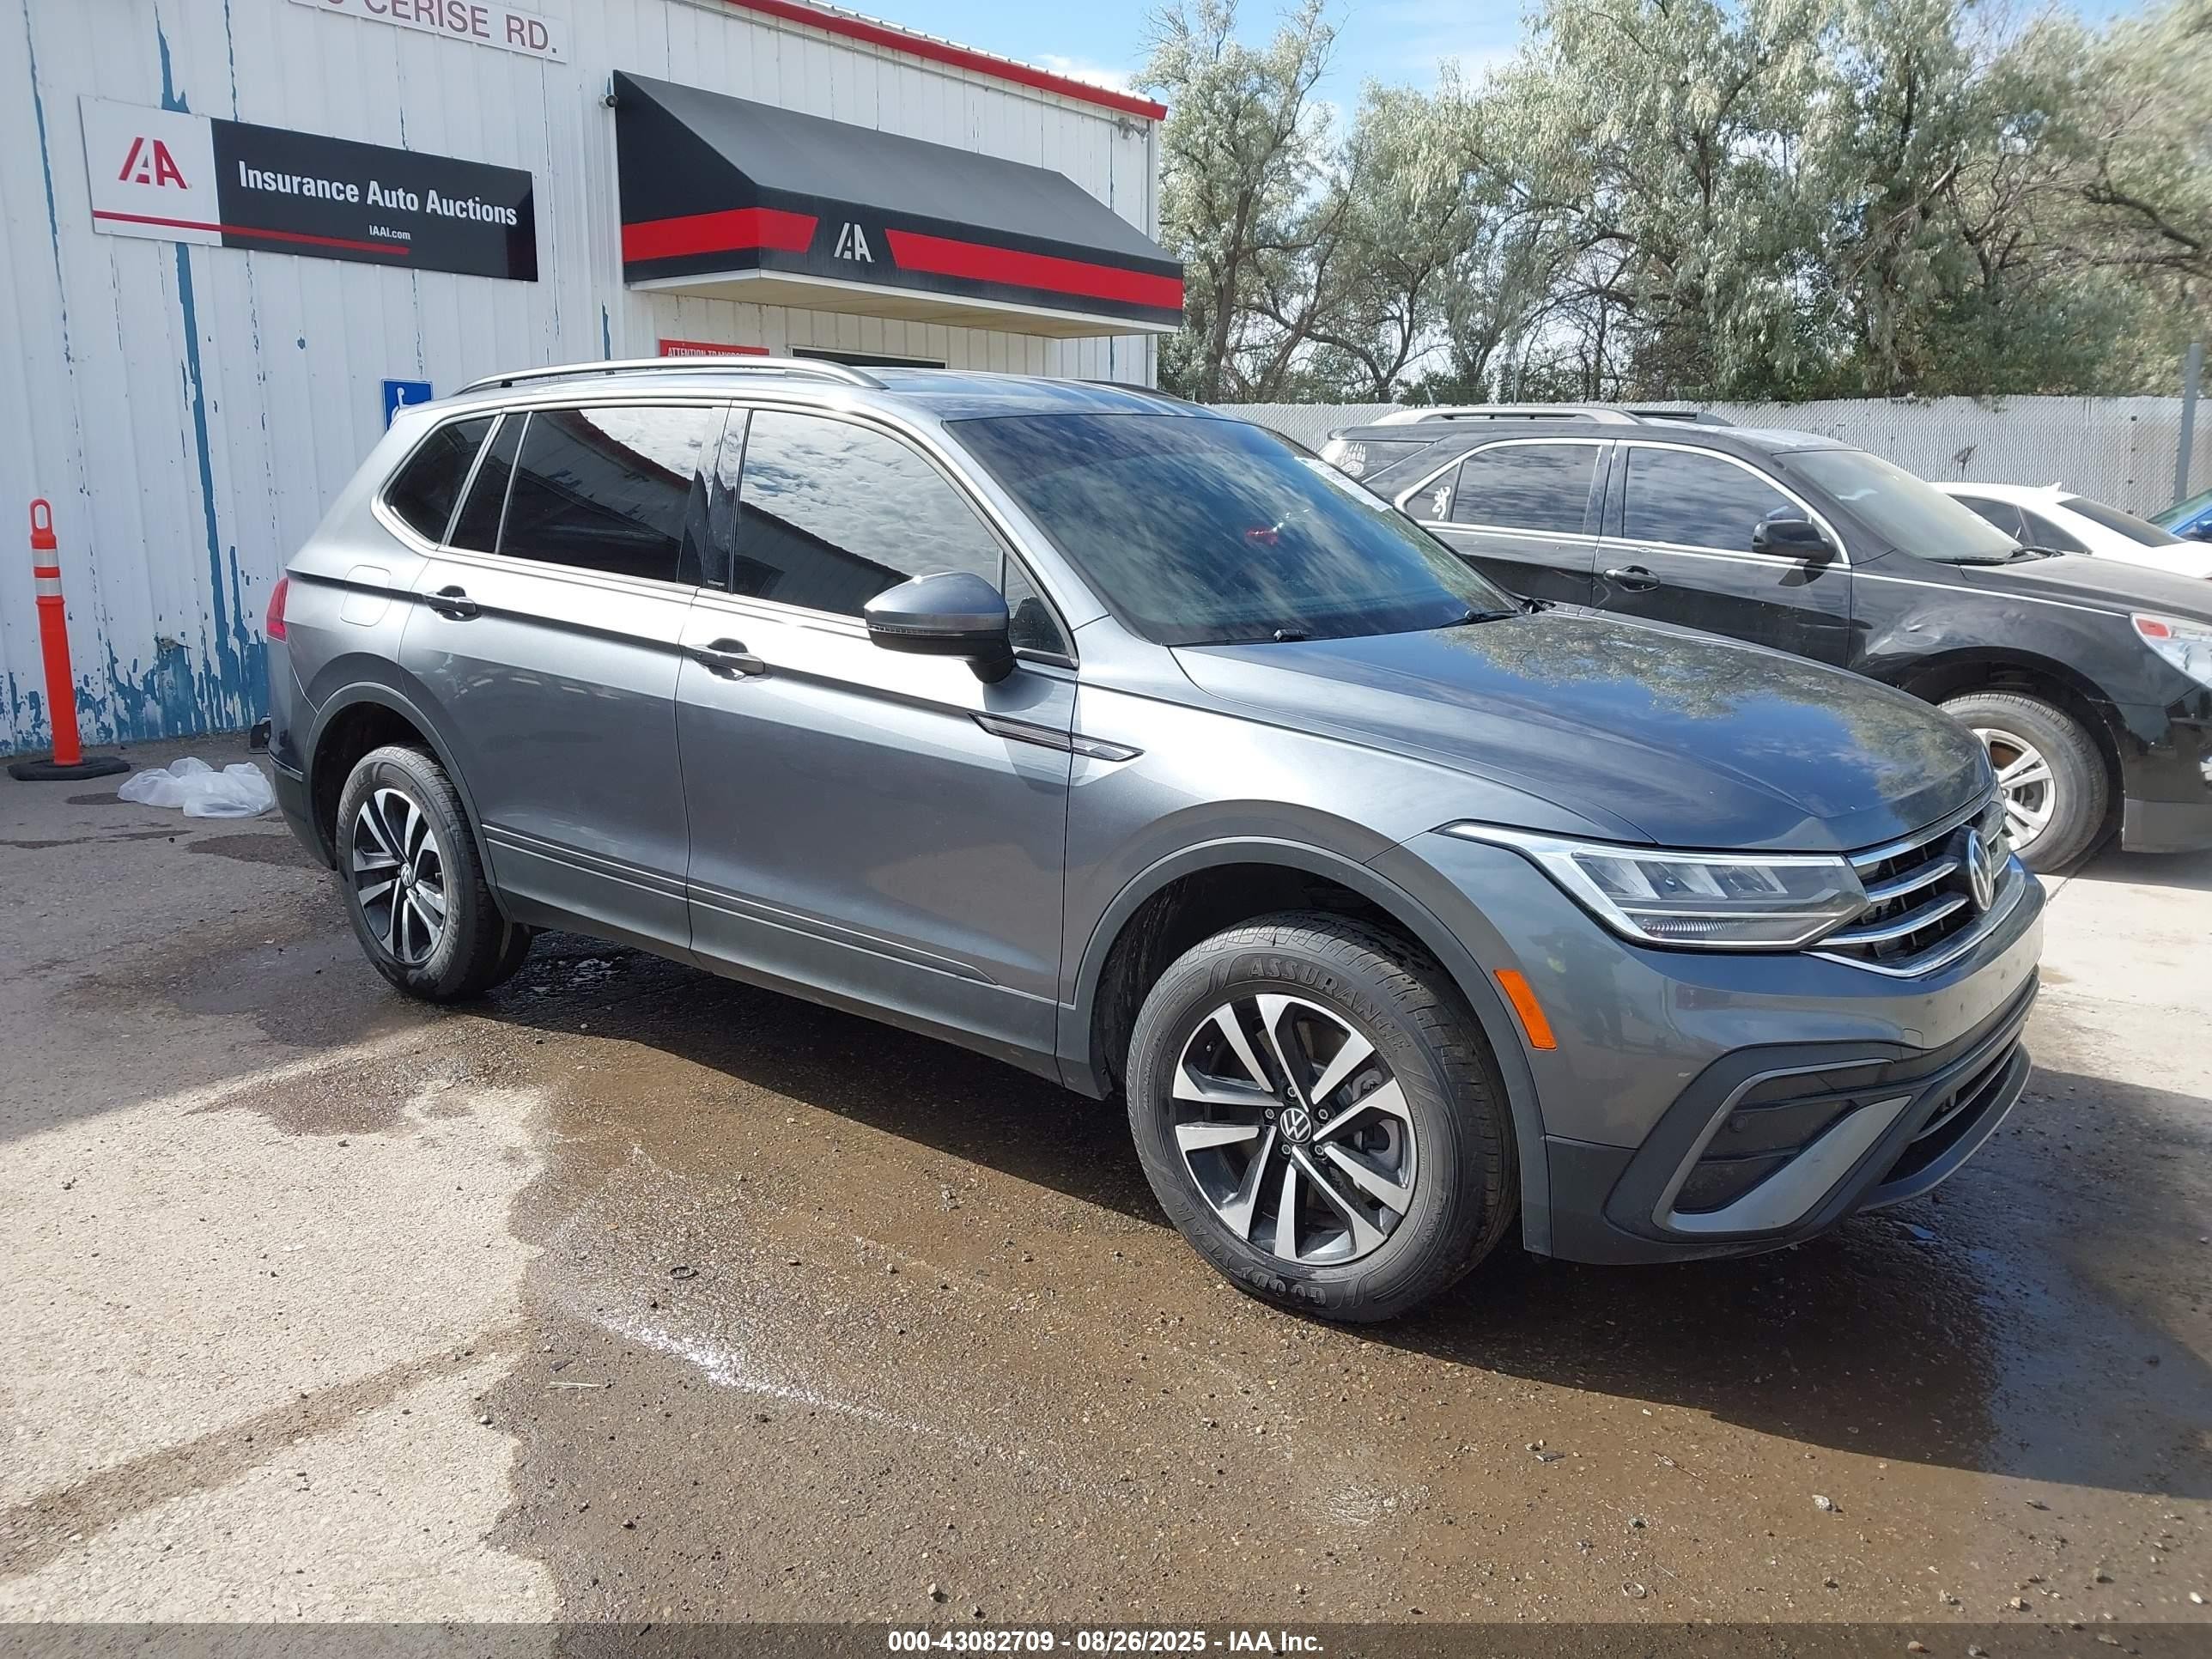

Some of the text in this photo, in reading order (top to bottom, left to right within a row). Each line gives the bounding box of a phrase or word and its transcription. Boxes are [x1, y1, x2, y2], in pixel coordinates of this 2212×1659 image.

[505, 13, 557, 53] RD.
[238, 160, 518, 226] Insurance Auto Auctions
[1248, 957, 1412, 1053] ASSURANCE
